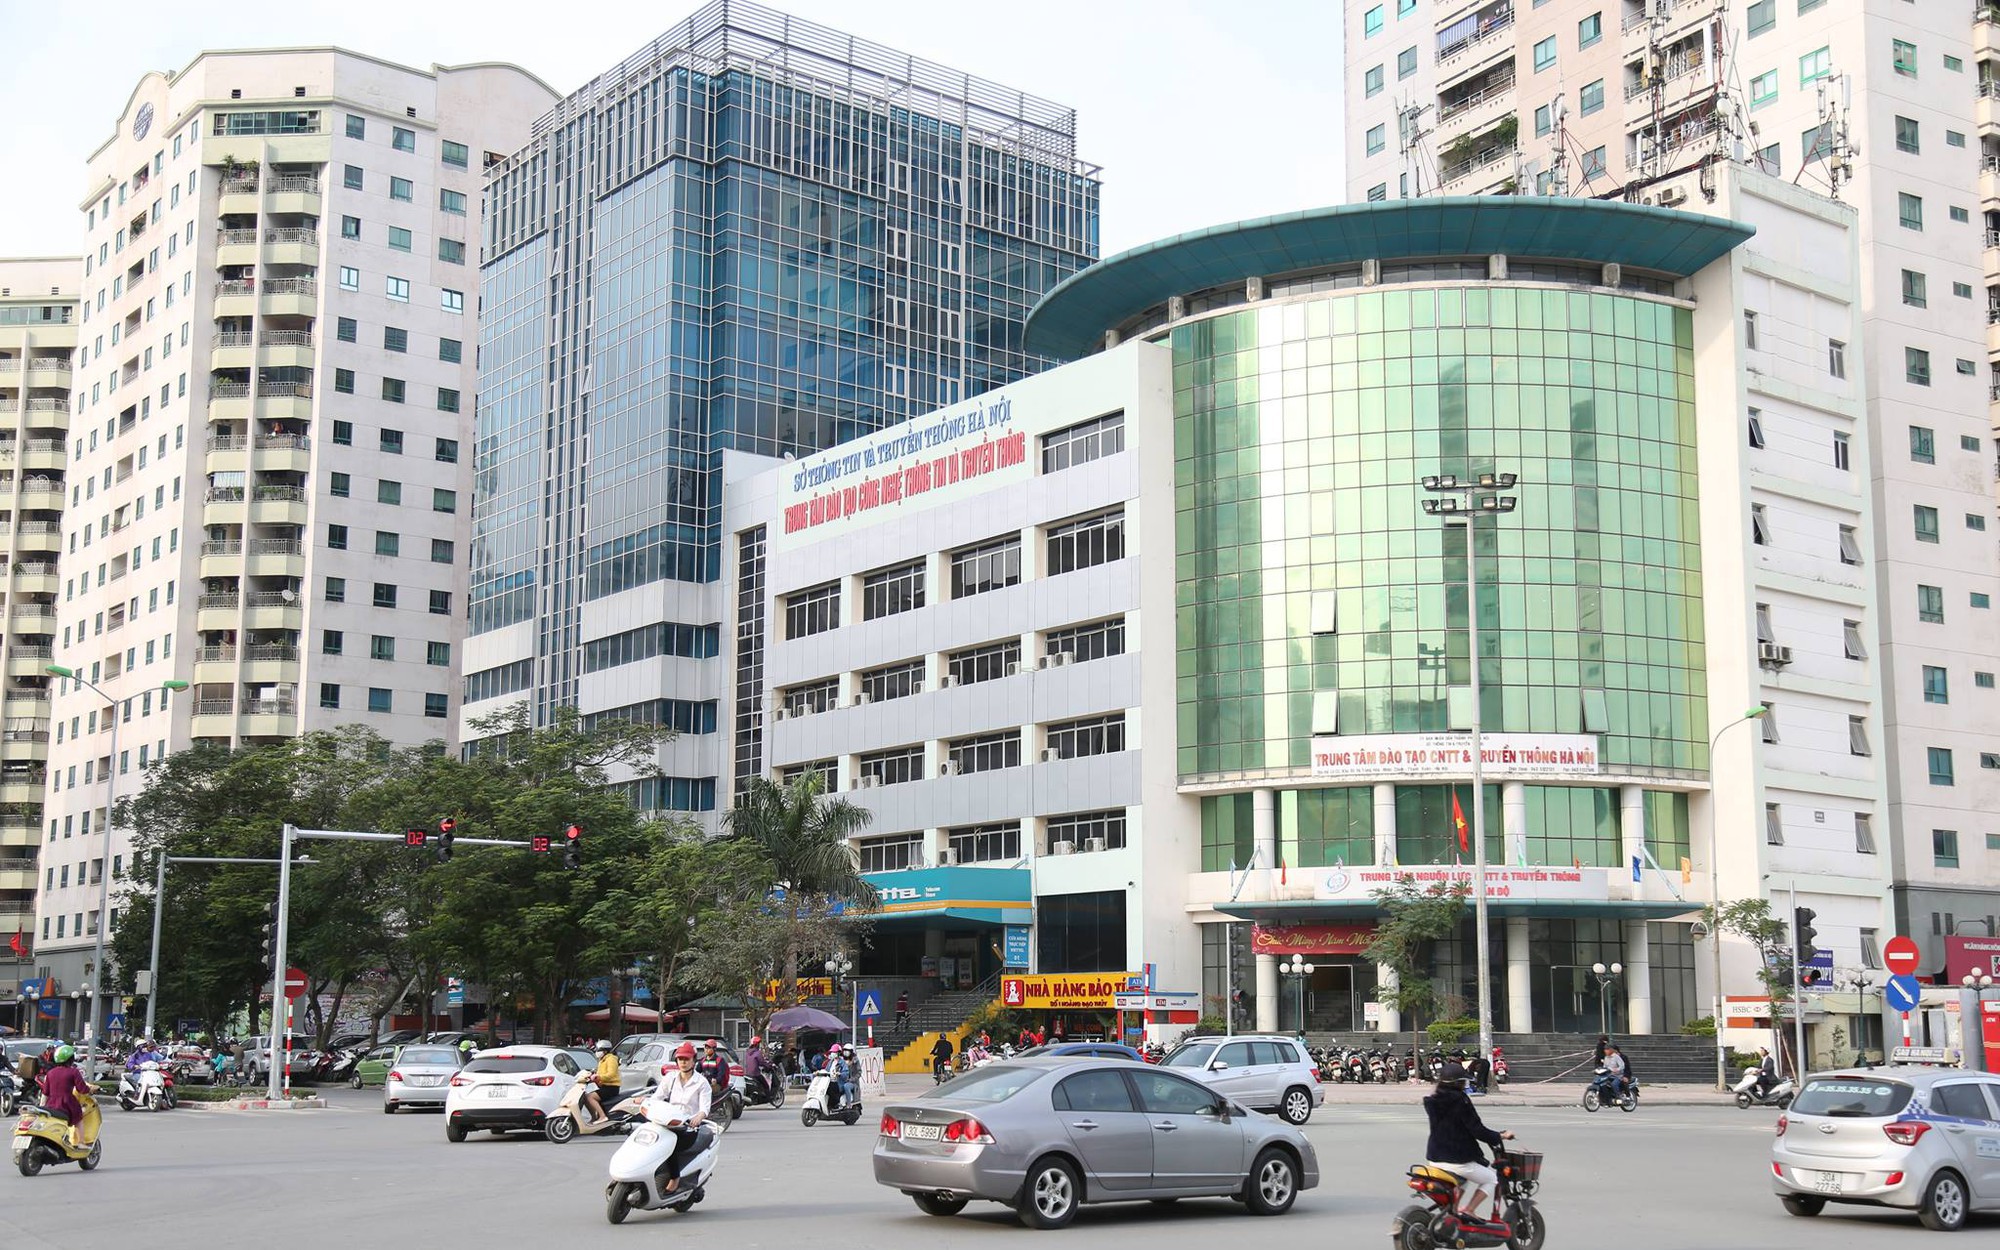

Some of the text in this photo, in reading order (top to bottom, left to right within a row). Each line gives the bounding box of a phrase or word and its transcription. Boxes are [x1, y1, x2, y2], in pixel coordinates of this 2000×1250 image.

[793, 395, 1012, 492] SỞ THÔNG TIN VÀ TRUYỀN THÔNG HÀ NỘI
[784, 428, 1026, 535] TRUNG TÂM ĐÀO TẠO CÔNG NGHỆ THÔNG TIN VÀ TRUYỀN THÔNG
[1315, 744, 1595, 768] TRUNG TÂM ĐÀO TẠO CNTT & RUYỀN THÔNG HÀ NỘI
[1359, 872, 1391, 881] TRUNG
[1501, 872, 1509, 881] &
[1511, 869, 1548, 881] TRUYỀN
[1550, 870, 1581, 882] THÔNG
[1497, 884, 1509, 897] BỘ
[1025, 978, 1050, 997] NHÀ
[1053, 978, 1086, 997] HÀNG
[1088, 978, 1113, 997] BẢO
[1114, 977, 1127, 993] TÍ
[1050, 999, 1059, 1007] SỐ
[1062, 999, 1081, 1007] HOÀNG
[1732, 1005, 1751, 1013] HSBC
[181, 1022, 188, 1032] P
